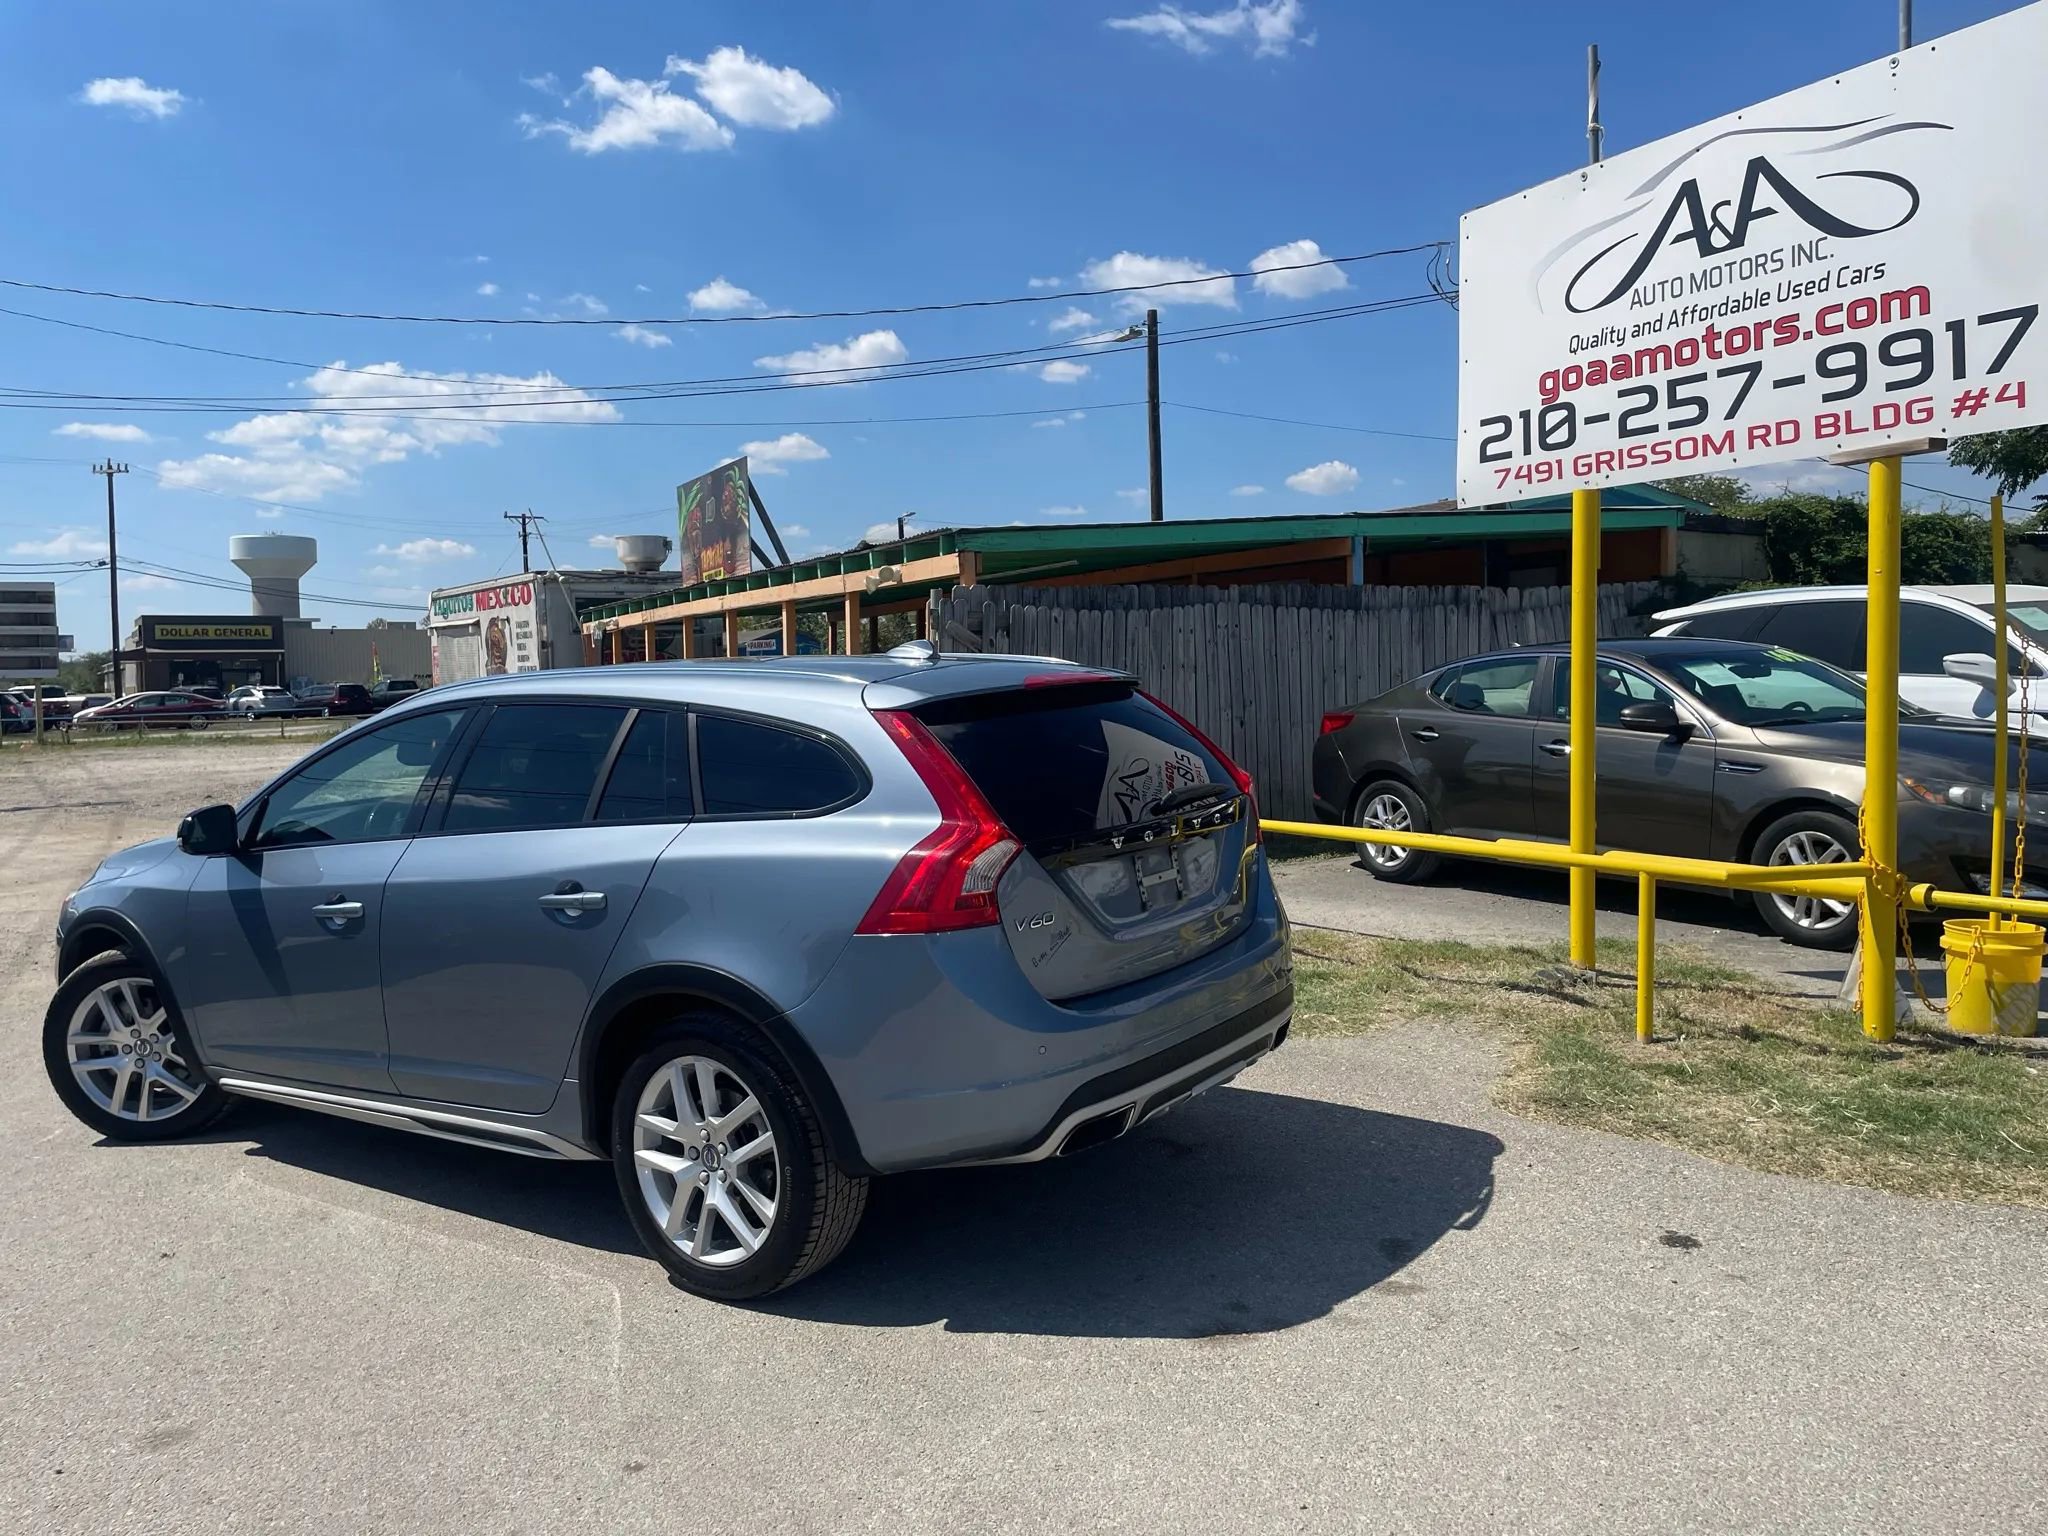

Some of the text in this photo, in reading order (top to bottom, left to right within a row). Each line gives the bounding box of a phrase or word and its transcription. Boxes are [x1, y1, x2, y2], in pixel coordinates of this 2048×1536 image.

[1630, 235, 1835, 312] AUTO MOTORS INC.
[1569, 261, 1887, 356] Quality and Affordable Used Cars
[1539, 284, 1930, 405] goaamotors.com
[1479, 304, 2040, 464] 210-257-9917
[1493, 380, 2026, 490] 7491 GRISSOM RD BLDG #4
[476, 582, 532, 612] MEXICO
[160, 628, 269, 637] DOLLAR GENERAL
[750, 640, 773, 650] PARKING
[1111, 813, 1221, 849] VOLVO
[1015, 912, 1055, 932] V60
